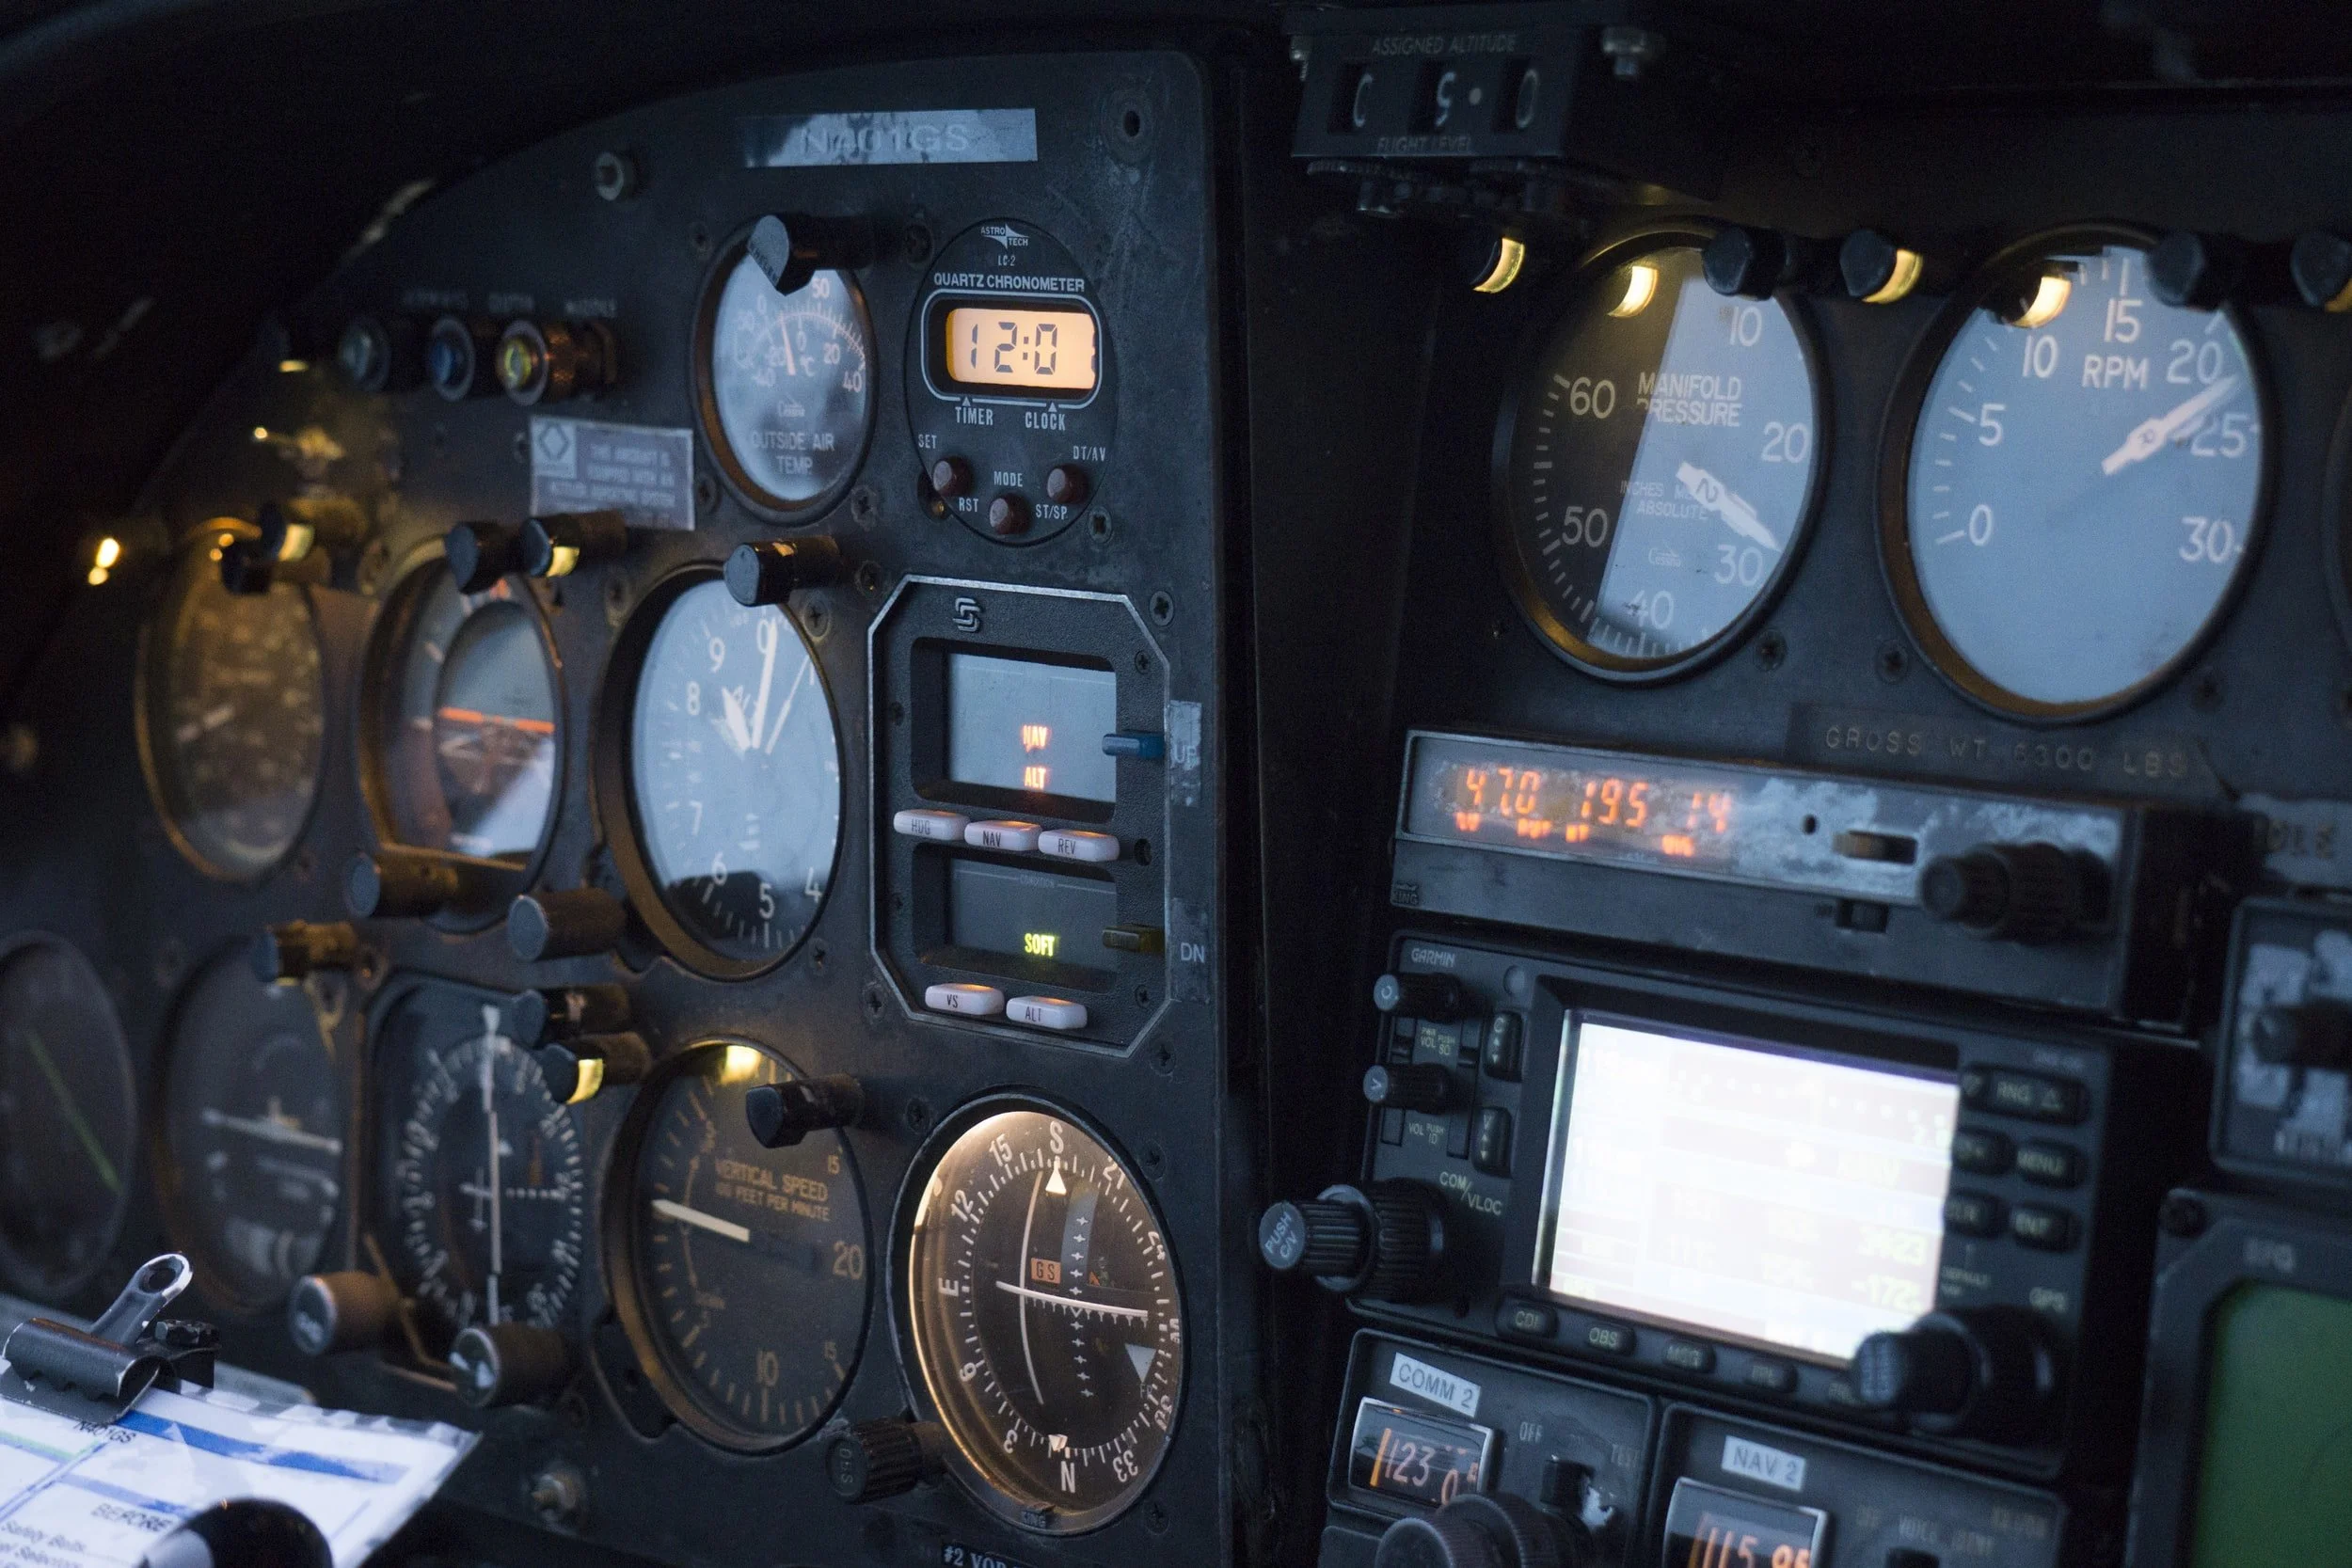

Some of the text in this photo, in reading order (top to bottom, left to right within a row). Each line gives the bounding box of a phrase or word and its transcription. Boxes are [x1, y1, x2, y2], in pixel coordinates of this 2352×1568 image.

[1372, 34, 1517, 55] ASSIGNED ALTITUDE
[980, 226, 1006, 235] ASTRO
[1009, 237, 1029, 246] TECH
[933, 273, 1085, 293] QUARTZ CHRONOMETER
[1728, 306, 1763, 346] 10
[2103, 299, 2143, 342] 15
[822, 342, 841, 365] 20
[971, 322, 1096, 375] 12:0
[2023, 334, 2058, 378] 10
[2167, 340, 2224, 385] 20
[1638, 372, 1741, 402] MANIFOLD
[2082, 354, 2149, 391] RPM
[1569, 376, 1616, 419] 60
[955, 406, 993, 425] TIMER
[1025, 412, 1066, 431] CLOCK
[1979, 404, 2007, 446] 5
[752, 431, 835, 451] OUTSIDE AIR
[918, 434, 937, 449] SET
[1073, 446, 1106, 461] DT/AV
[1760, 420, 1811, 463] 20
[993, 471, 1024, 487] MODE
[1619, 480, 1664, 497] INCHES
[959, 498, 979, 513] RST
[1035, 504, 1068, 519] ST/SP
[1636, 500, 1709, 520] ABSOLUTE
[1563, 506, 1608, 547] 50
[1969, 504, 1993, 546] 0
[2179, 516, 2234, 563] 30
[1713, 544, 1763, 586] 30
[1626, 590, 1675, 630] 40
[708, 637, 726, 673] 9
[686, 680, 701, 716] 8
[1023, 725, 1048, 748] NAV
[1826, 727, 1922, 755] GROSS
[1949, 737, 1986, 760] WT
[1025, 767, 1047, 789] ALT
[1581, 777, 1649, 828] 195
[690, 801, 704, 836] 7
[911, 818, 931, 836] HDG
[982, 831, 1002, 847] NAV
[1057, 838, 1077, 855] REV
[710, 851, 728, 886] 6
[804, 866, 822, 903] 4
[759, 882, 775, 920] 5
[1024, 933, 1056, 957] SOFT
[1180, 942, 1205, 963] DN
[1411, 947, 1455, 967] GARMIN
[946, 993, 959, 1009] VS
[1025, 1006, 1042, 1022] ALT
[1421, 1036, 1437, 1049] VOL
[1050, 1120, 1064, 1154] S
[1408, 1122, 1445, 1136] VOL PUSH
[990, 1133, 1014, 1164] 15
[715, 1159, 828, 1202] VERTICAL SPEED
[950, 1188, 976, 1223] 12
[1264, 1211, 1292, 1254] PUSH
[833, 1241, 865, 1280] 20
[938, 1277, 960, 1298] E
[1588, 1326, 1618, 1348] OBS
[755, 1350, 779, 1387] 10
[1398, 1363, 1474, 1408] COMM 2
[1003, 1429, 1019, 1454] 3
[1519, 1421, 1543, 1443] OFF
[1060, 1460, 1076, 1494] N
[1112, 1449, 1139, 1484] 33
[1732, 1446, 1798, 1483] NAV 2
[944, 1544, 964, 1567] #2
